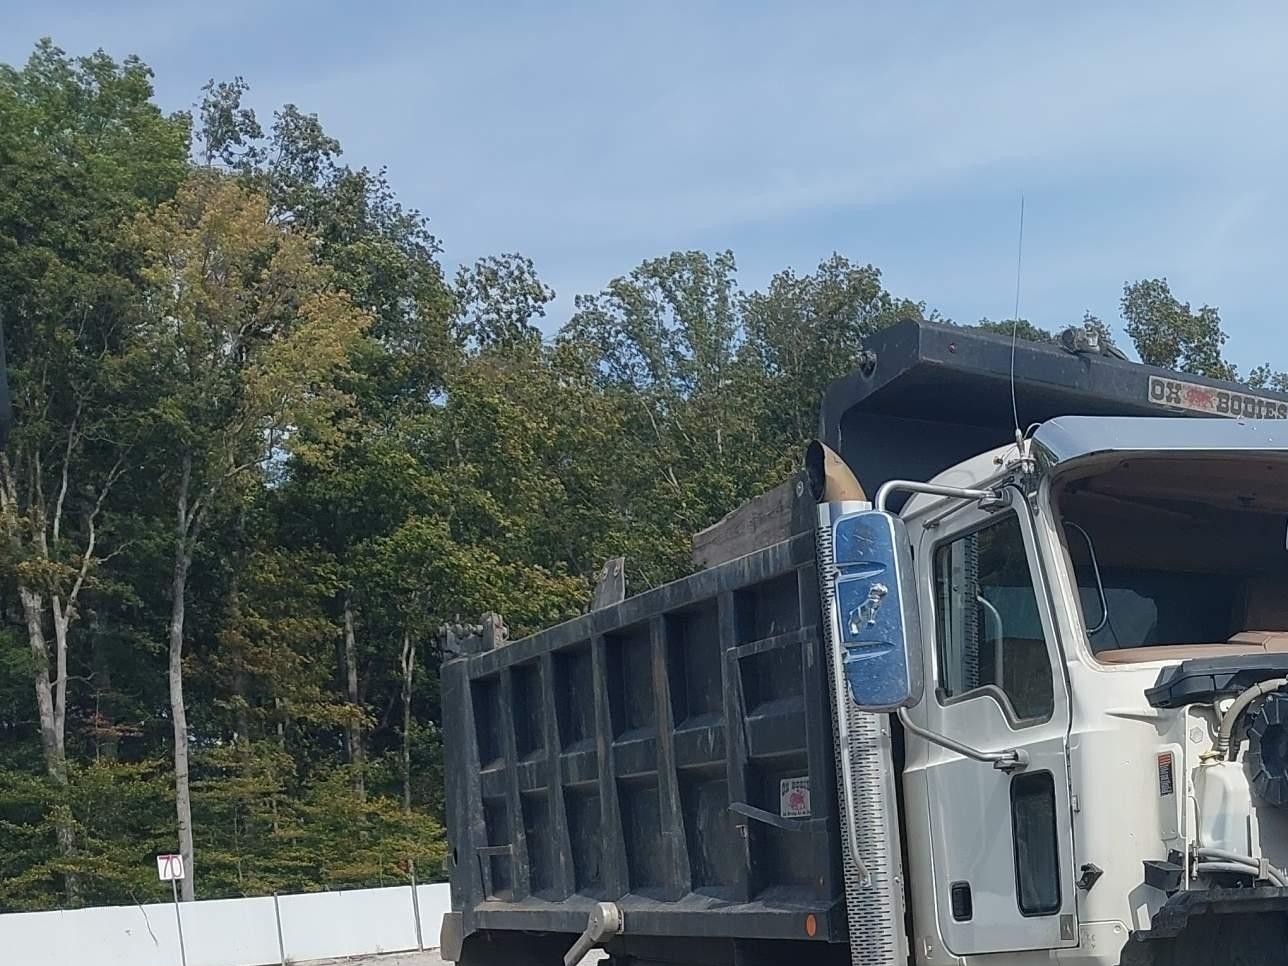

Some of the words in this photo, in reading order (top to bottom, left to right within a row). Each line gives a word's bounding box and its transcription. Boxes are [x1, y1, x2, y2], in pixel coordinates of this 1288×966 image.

[1151, 379, 1182, 405] OX
[1216, 391, 1288, 419] BODIES
[158, 855, 183, 878] 70
